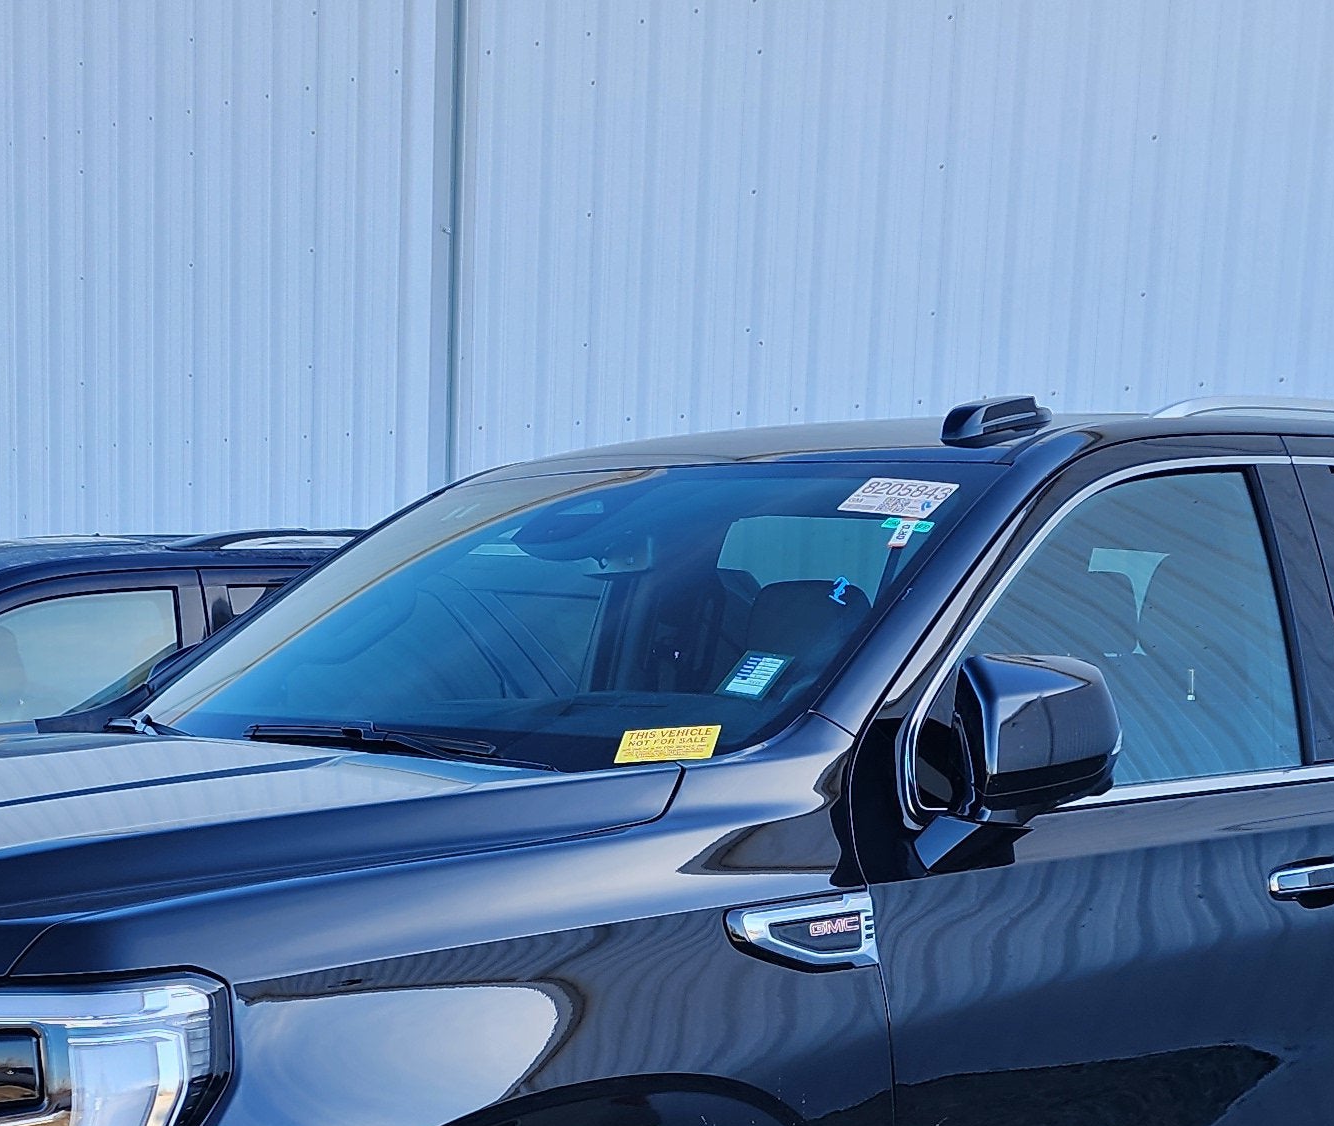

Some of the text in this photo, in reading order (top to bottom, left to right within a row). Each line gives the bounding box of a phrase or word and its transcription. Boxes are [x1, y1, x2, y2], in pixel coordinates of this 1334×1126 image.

[862, 481, 953, 501] 8205843
[629, 727, 713, 741] THIS VEHICLE
[679, 736, 708, 744] SALE
[810, 916, 860, 937] GMC
